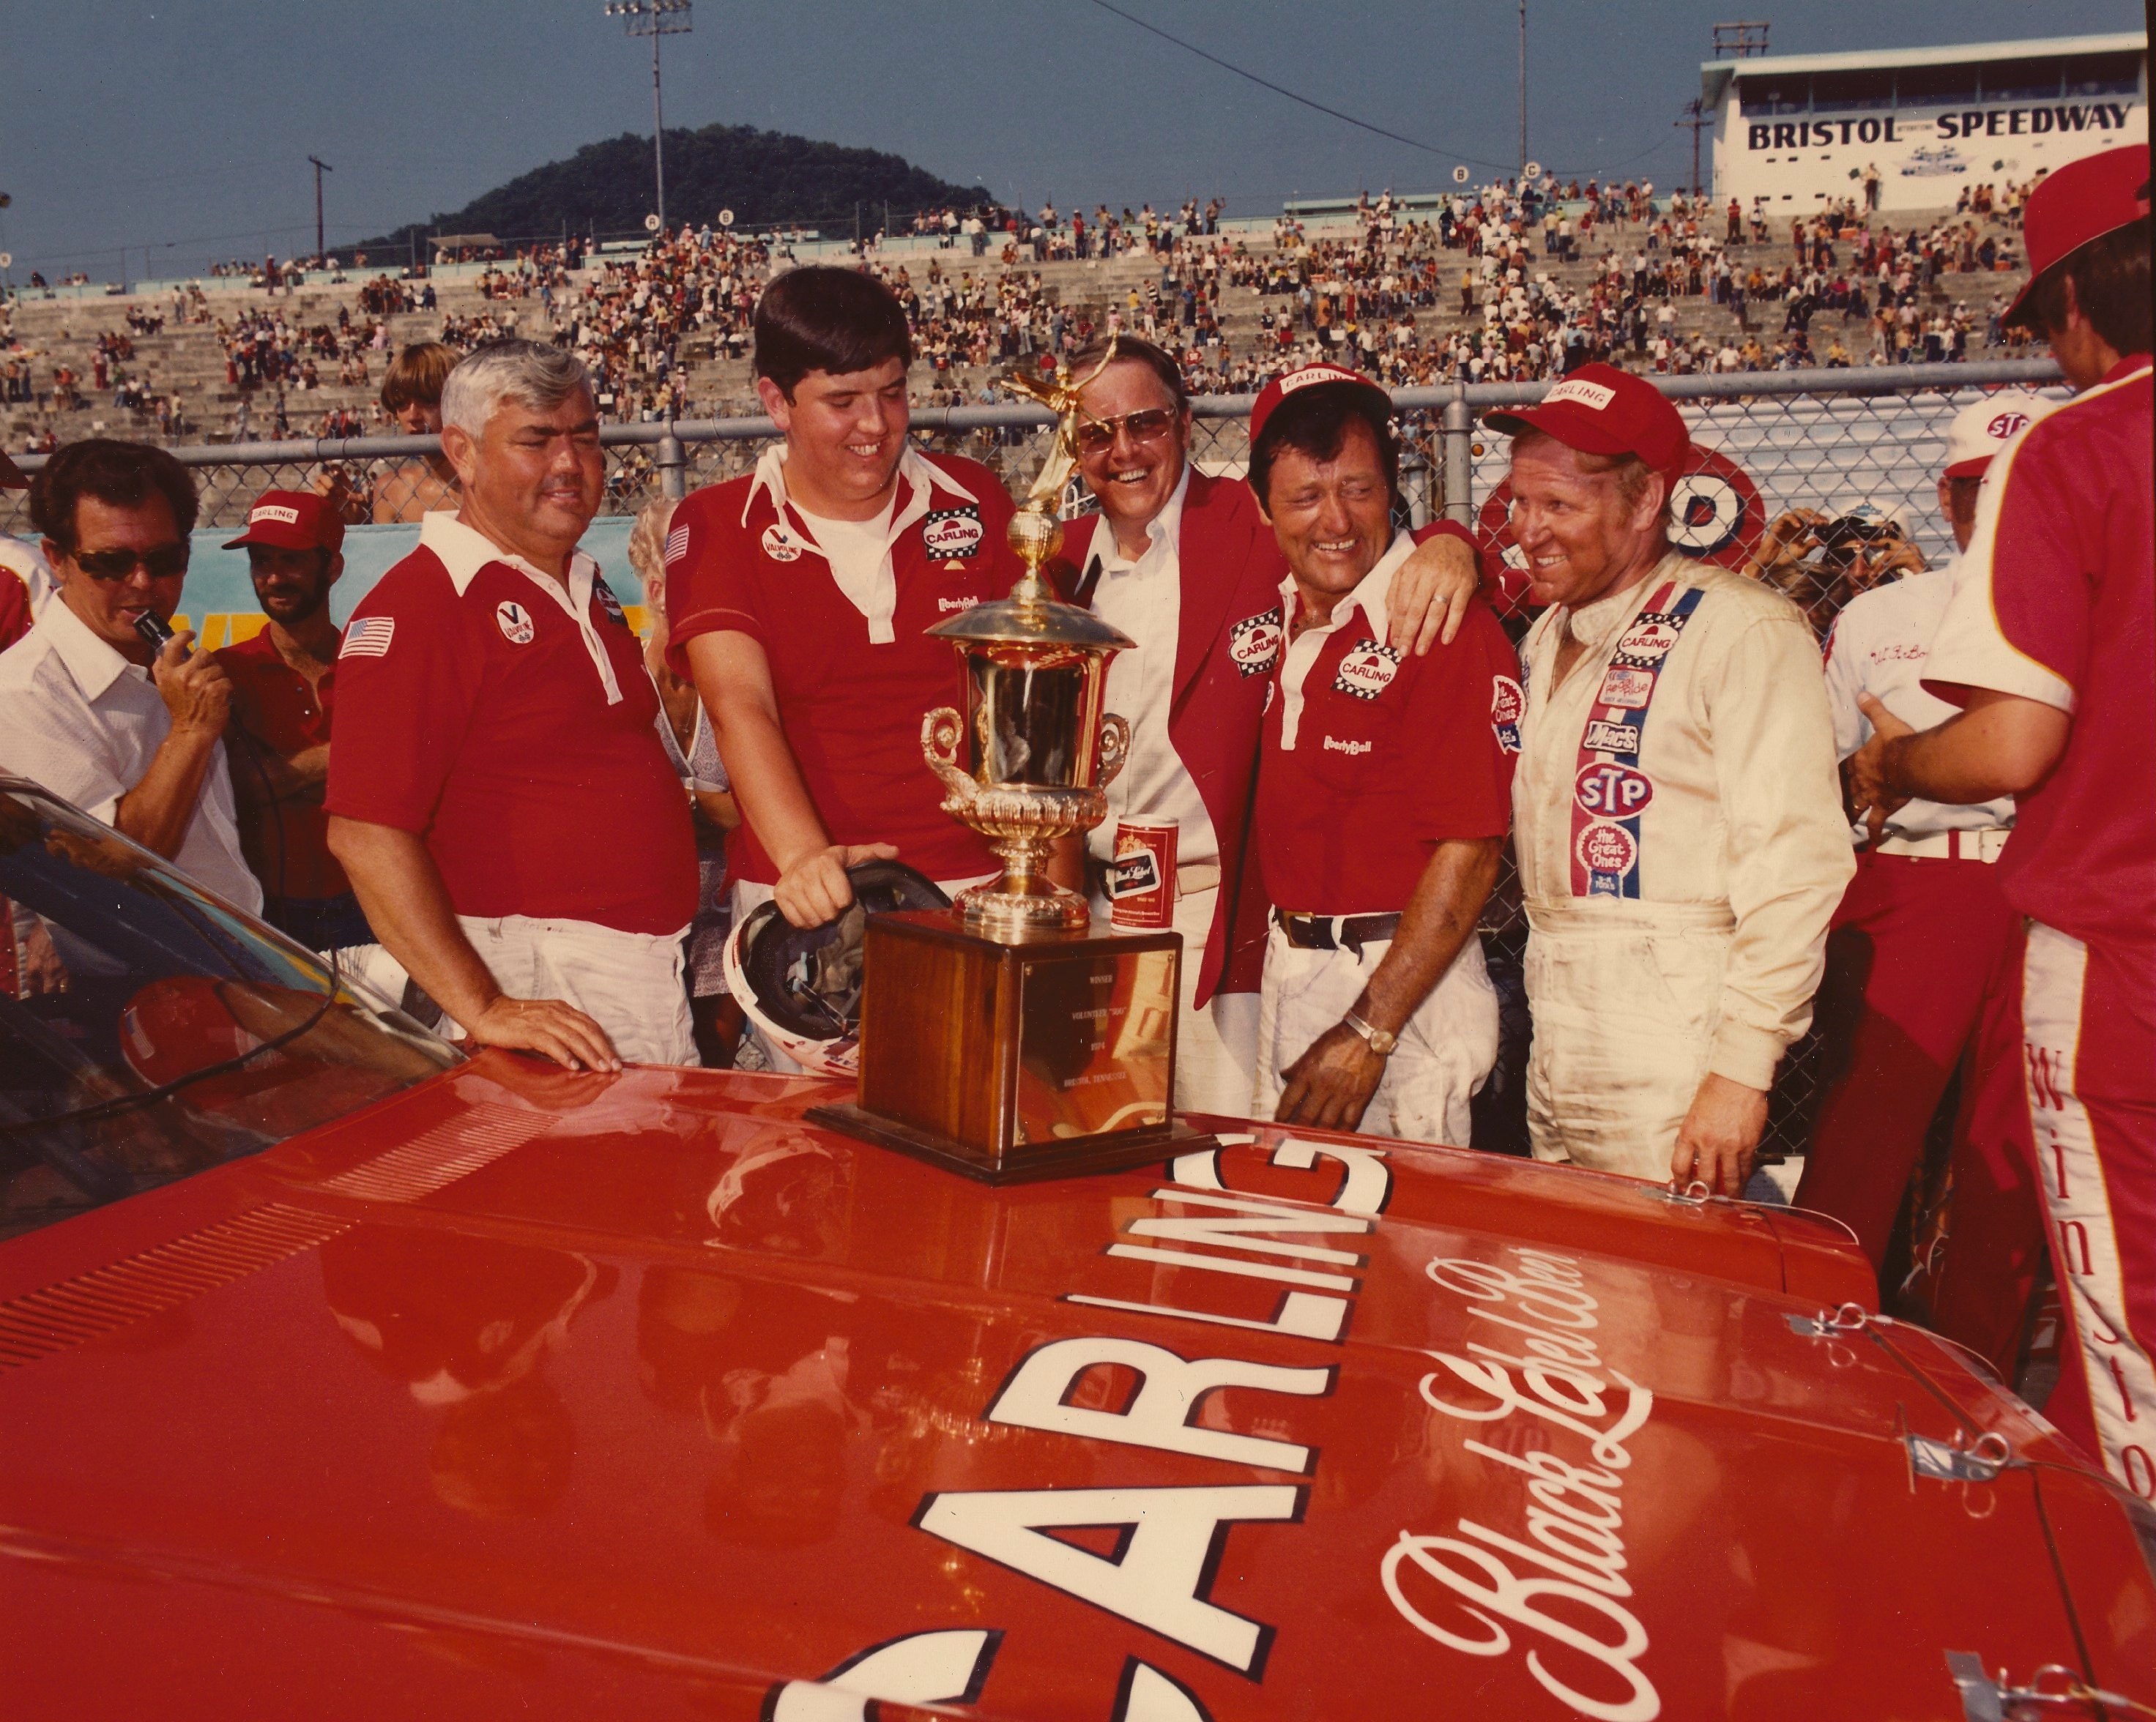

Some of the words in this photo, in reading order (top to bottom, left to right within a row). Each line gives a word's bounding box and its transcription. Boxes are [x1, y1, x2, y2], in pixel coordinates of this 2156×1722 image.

[1747, 117, 1903, 151] BRISTOL
[1936, 102, 2134, 139] SPEEDWAY
[1457, 169, 1464, 180] B
[1528, 165, 1536, 176] C
[1286, 372, 1343, 387] CARLIN
[926, 529, 979, 544] CARLING
[765, 542, 799, 556] VALVOLINE
[1237, 634, 1279, 660] CARLING
[1621, 637, 1671, 649] CARLING
[1342, 662, 1391, 683] CARLING
[1495, 708, 1517, 723] Ones
[1580, 767, 1648, 813] STP
[1588, 839, 1626, 855] Great
[1591, 853, 1623, 868] Ones
[1090, 974, 1113, 984] WINNER
[1072, 1008, 1107, 1020] VOLUNTEER
[1093, 1071, 1126, 1084] TENNESSEE
[1425, 1247, 1599, 1329] Beer
[1419, 1307, 1653, 1469] Label
[1380, 1438, 1661, 1722] Black
